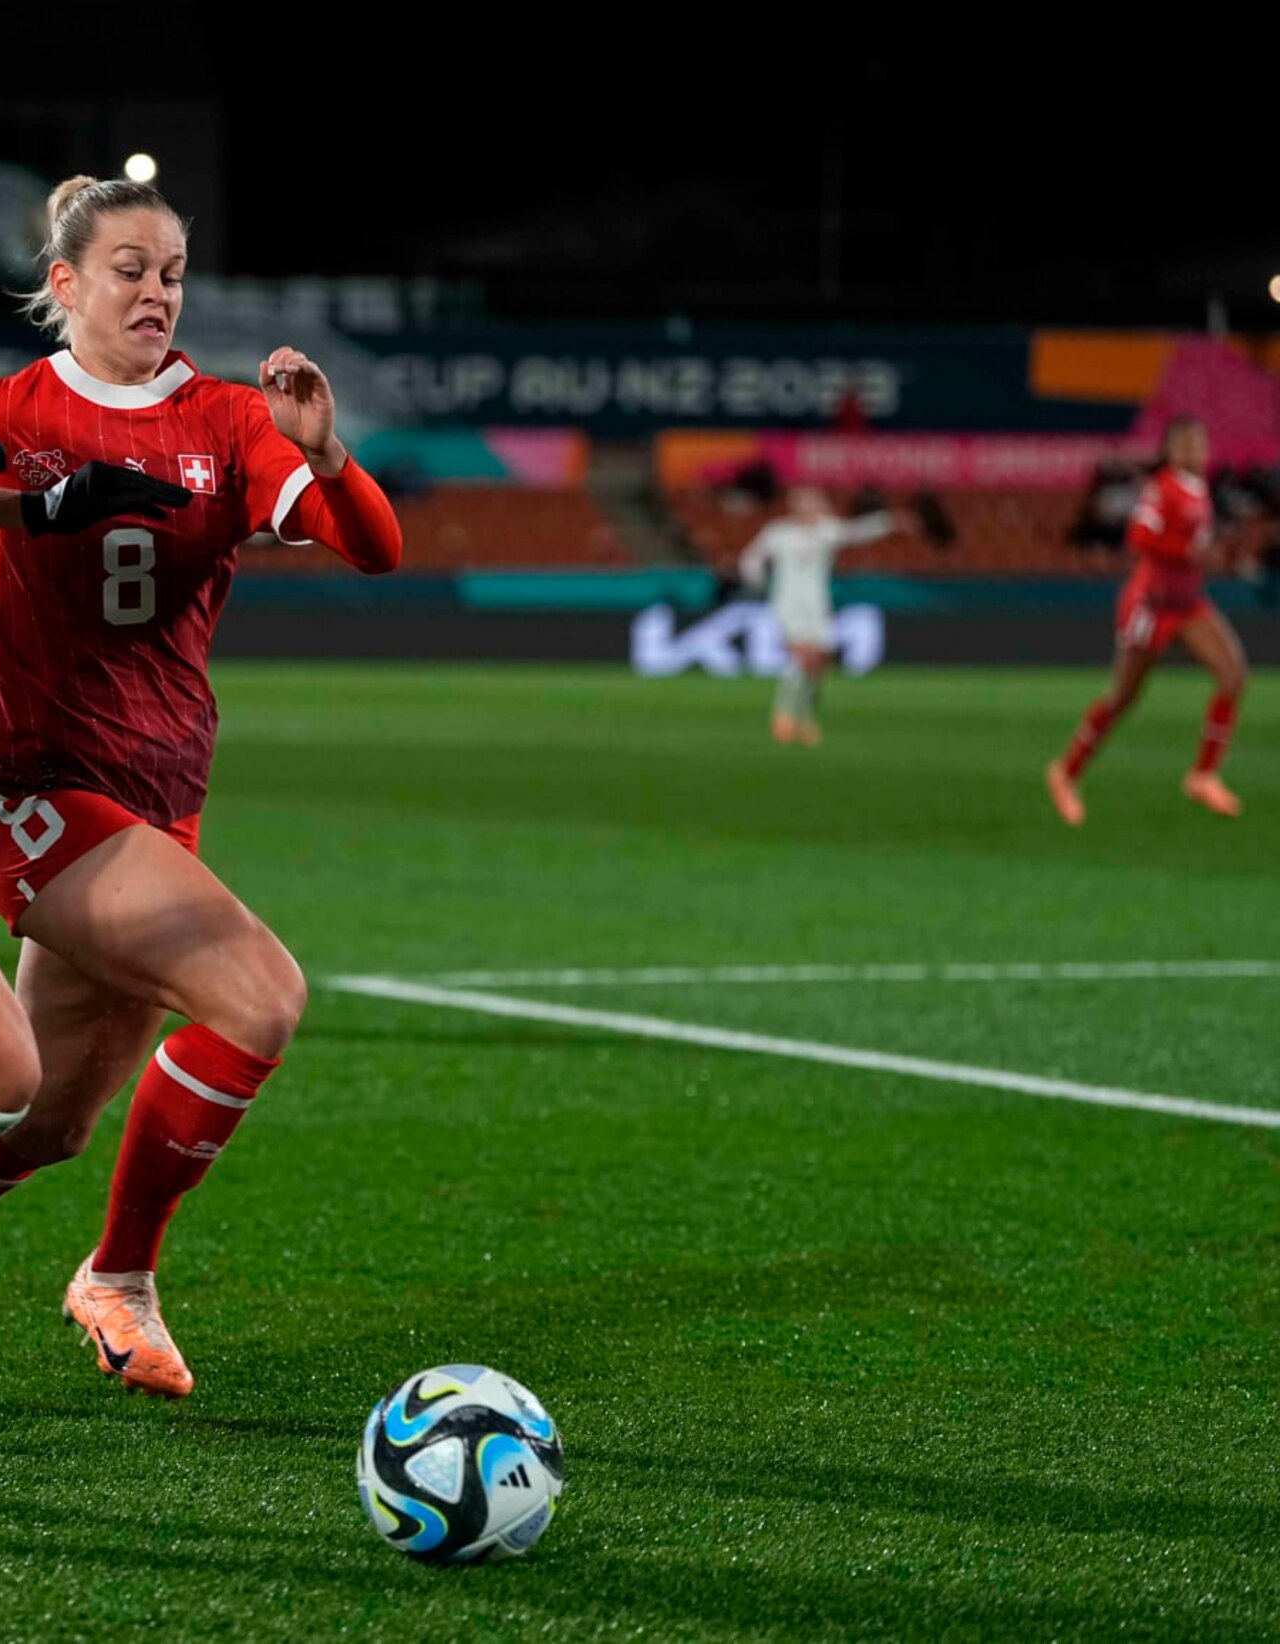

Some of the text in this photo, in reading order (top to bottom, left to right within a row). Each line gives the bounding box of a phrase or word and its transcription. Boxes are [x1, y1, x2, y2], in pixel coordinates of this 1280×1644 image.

[511, 358, 611, 413] AU
[617, 358, 711, 414] NZ
[720, 359, 900, 416] 2023
[797, 436, 958, 478] BEYOND
[103, 528, 156, 626] 8
